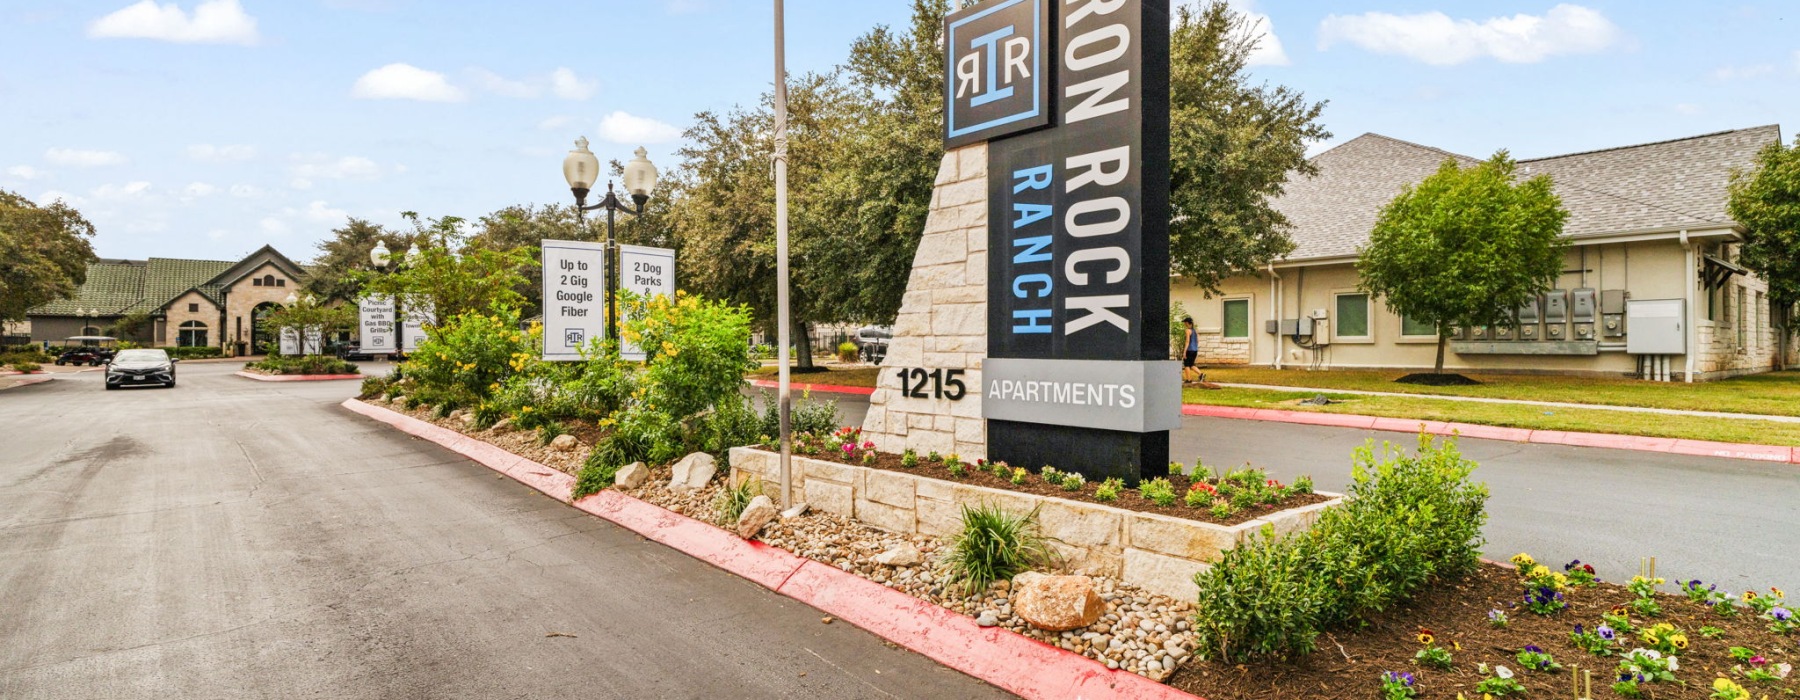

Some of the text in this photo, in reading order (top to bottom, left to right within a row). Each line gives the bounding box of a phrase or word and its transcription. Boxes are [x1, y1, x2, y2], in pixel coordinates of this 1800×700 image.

[1065, 145, 1131, 335] ROCK
[1012, 164, 1053, 334] RANCH
[560, 259, 588, 271] Up to
[634, 262, 662, 275] 2 Dog
[560, 275, 588, 288] 2 Gig
[634, 275, 662, 286] Parks
[556, 290, 593, 303] Google
[561, 306, 588, 316] Fiber
[897, 368, 966, 400] 1215
[989, 379, 1136, 409] APARTMENTS
